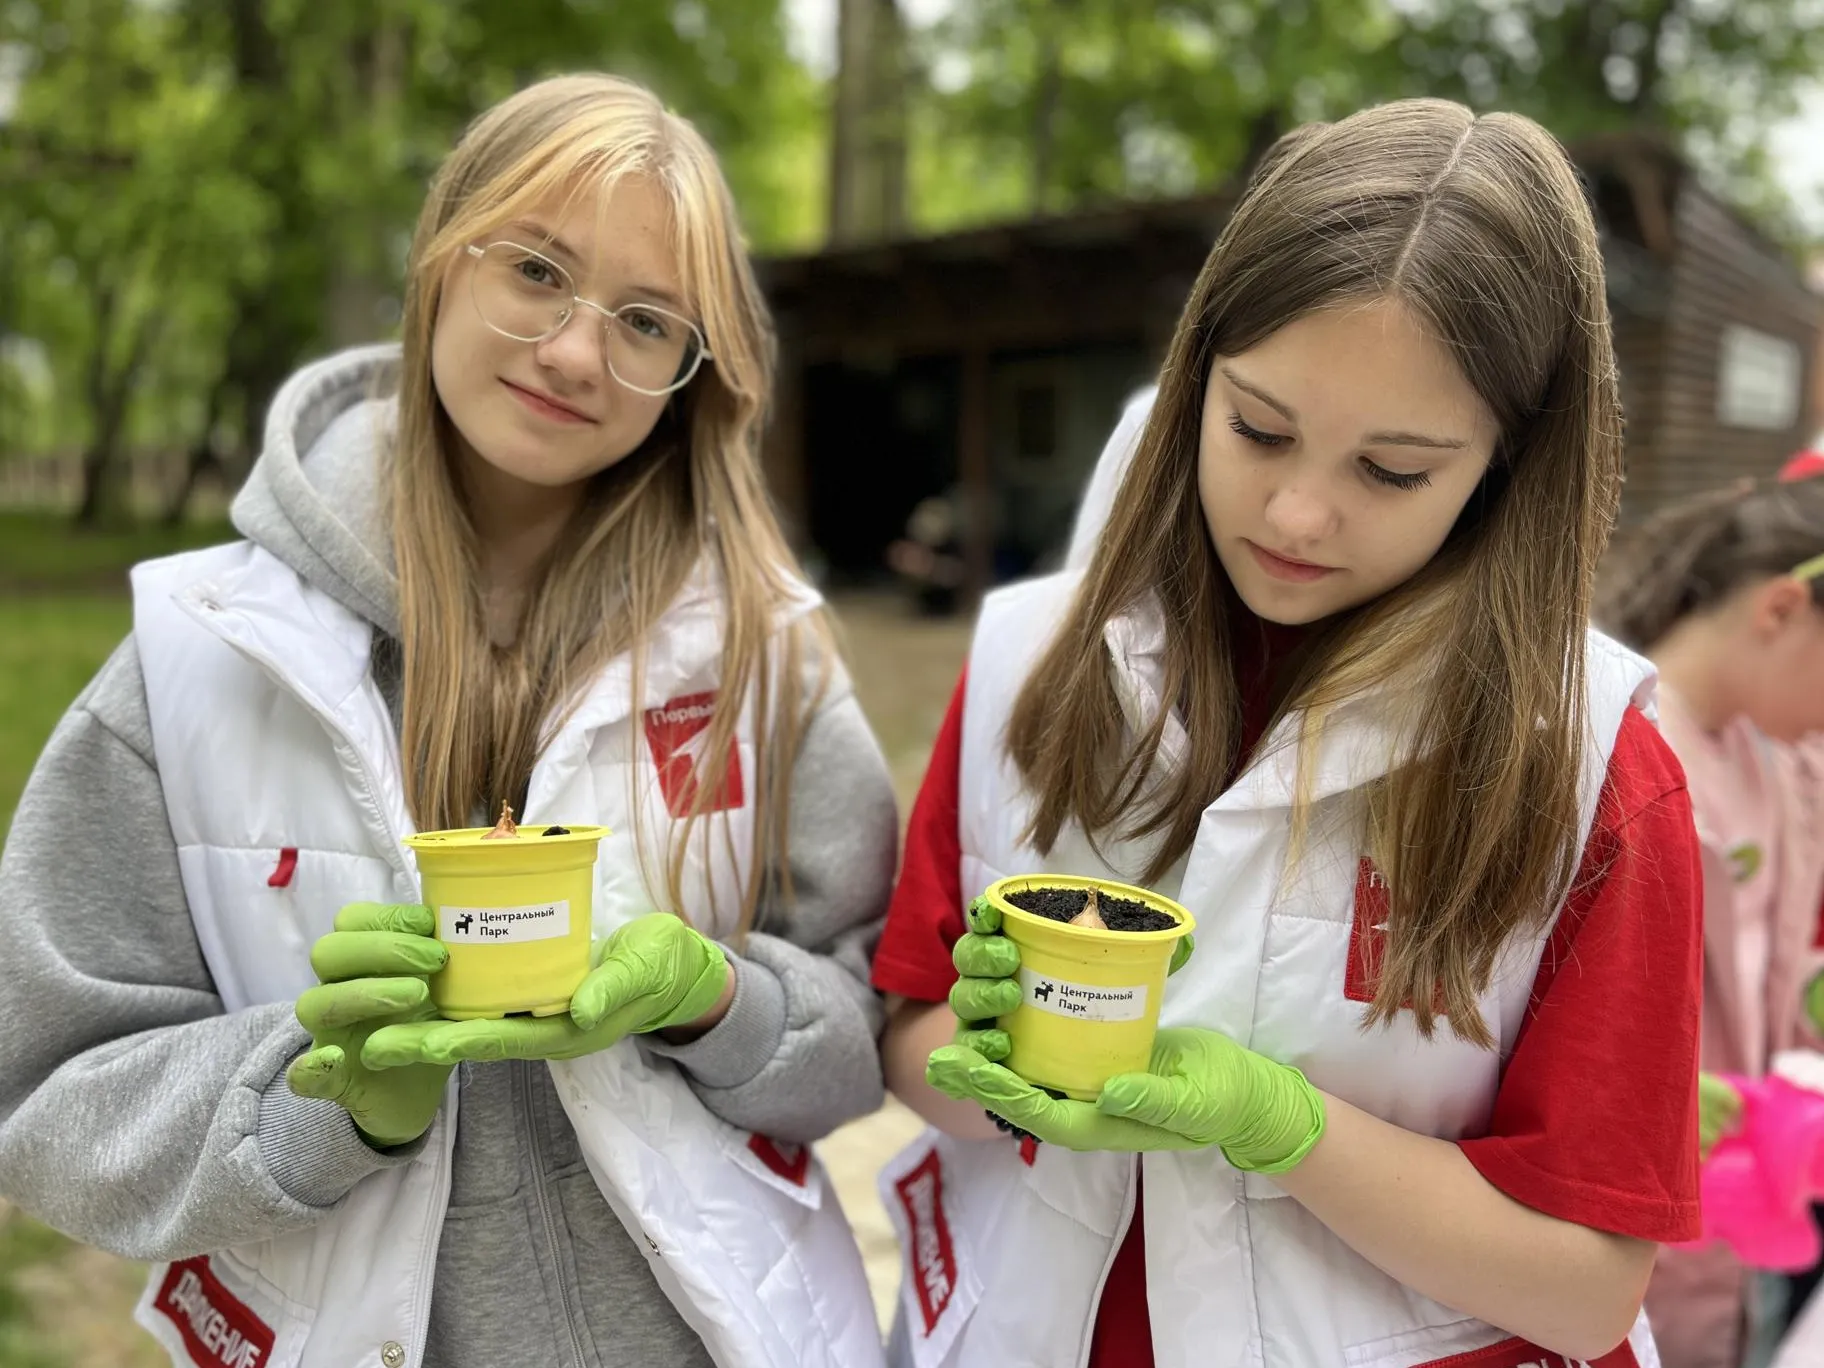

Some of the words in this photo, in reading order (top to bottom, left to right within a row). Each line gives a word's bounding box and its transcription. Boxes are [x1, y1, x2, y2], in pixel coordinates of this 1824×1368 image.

[480, 906, 555, 924] Центральный
[480, 926, 509, 938] Парк
[1060, 984, 1133, 1001] Центральный
[1058, 999, 1087, 1013] Парк
[167, 1267, 262, 1368] ДЖЕНИЕ
